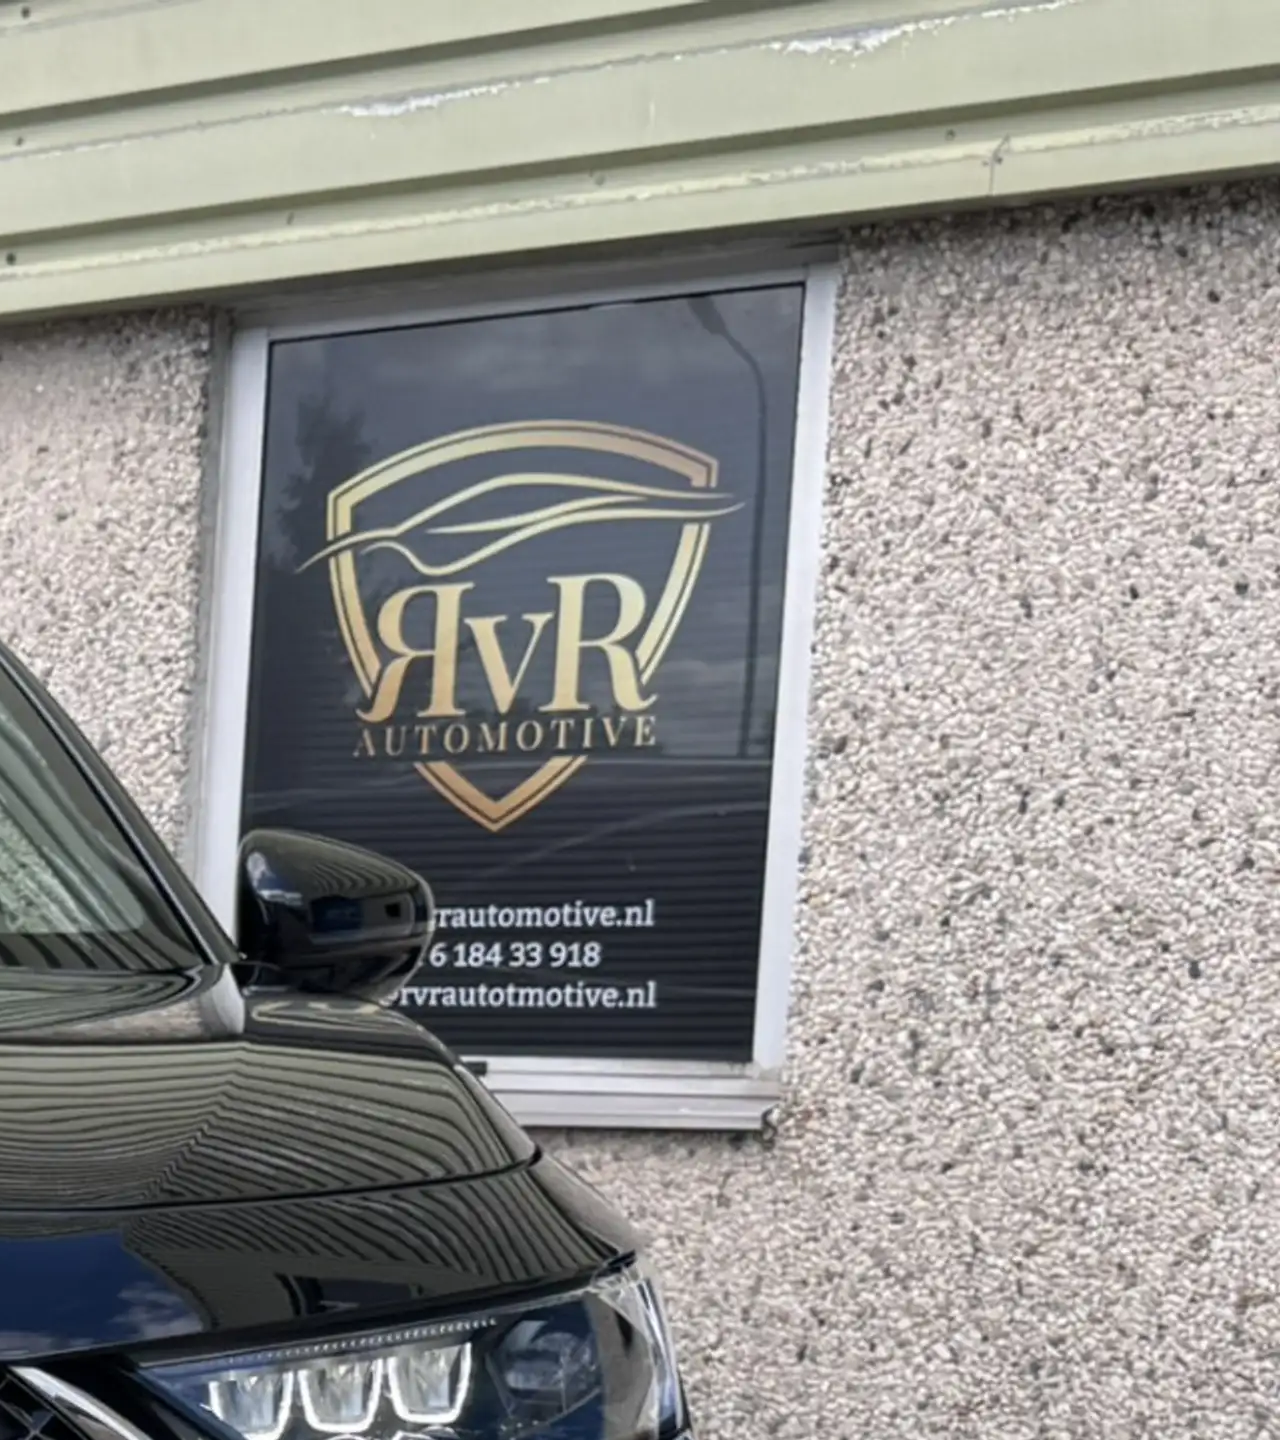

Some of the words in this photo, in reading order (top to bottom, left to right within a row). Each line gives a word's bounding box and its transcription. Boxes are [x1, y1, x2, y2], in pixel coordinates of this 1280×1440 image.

[352, 715, 658, 757] AUTOMOTIVE
[453, 942, 503, 968] 184
[509, 942, 541, 967] 33
[549, 941, 602, 968] 918
